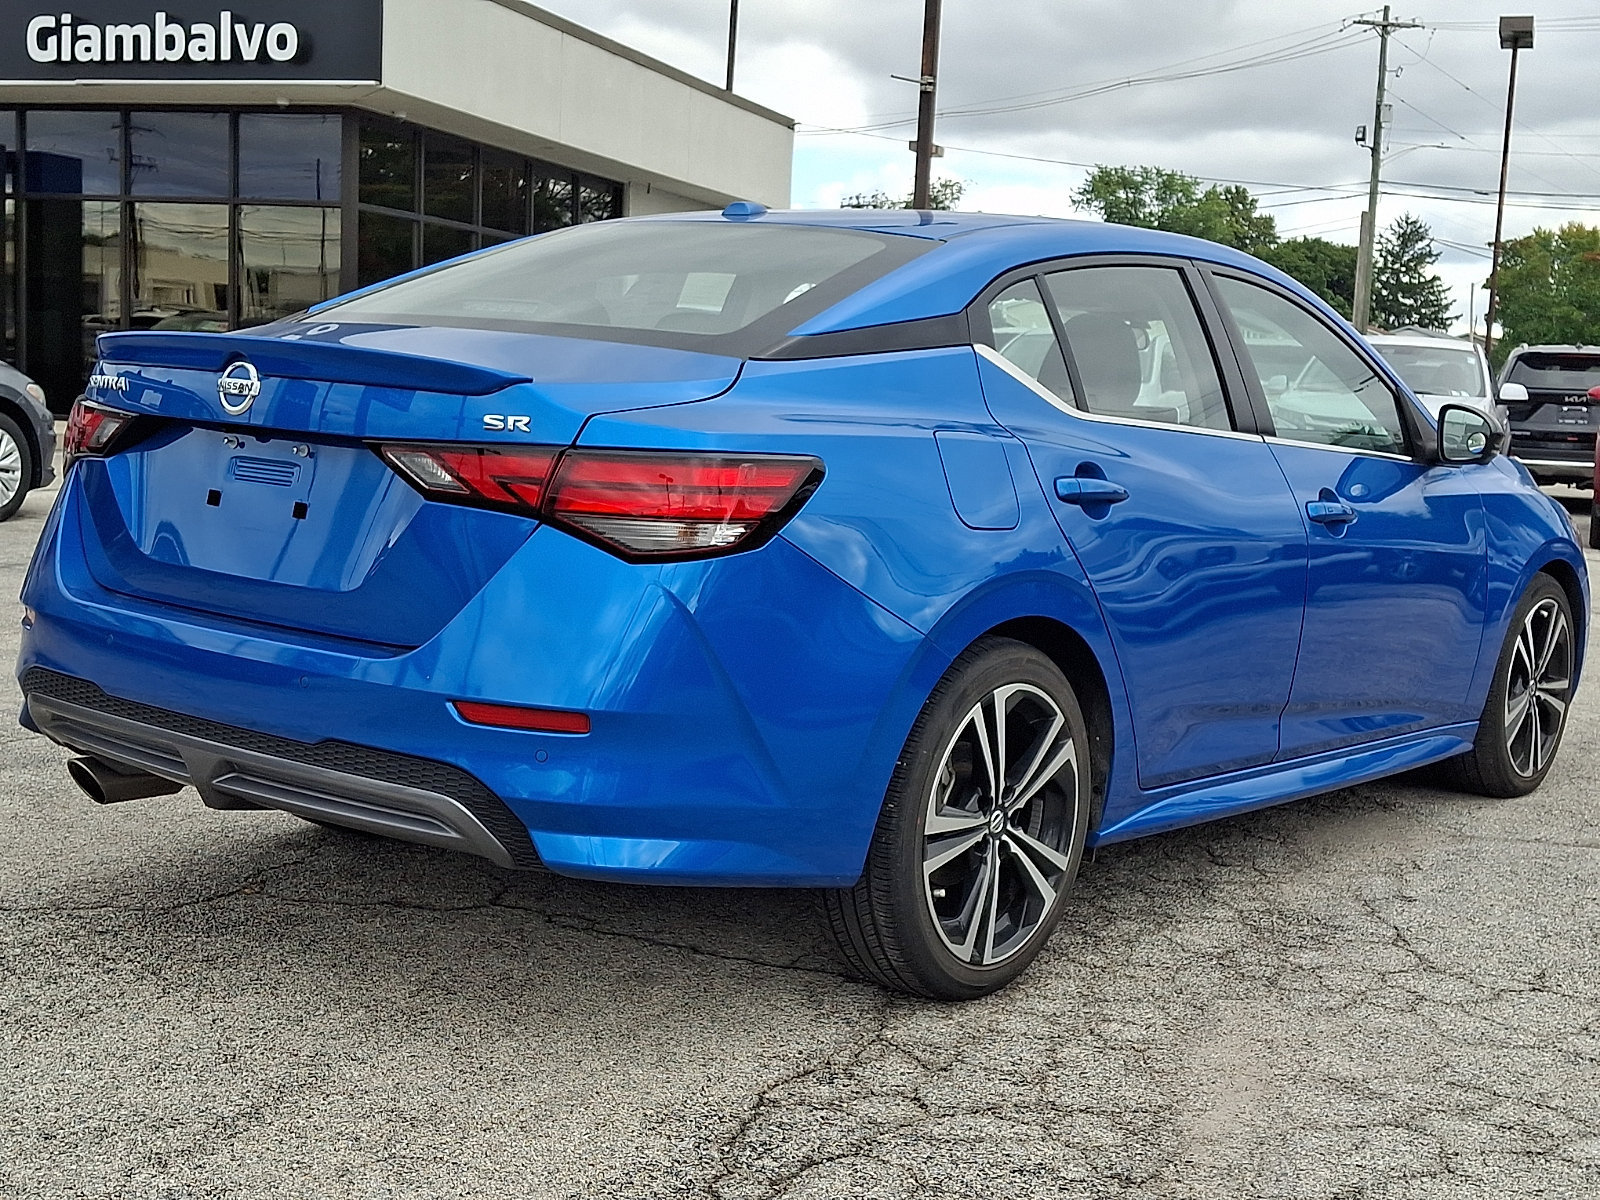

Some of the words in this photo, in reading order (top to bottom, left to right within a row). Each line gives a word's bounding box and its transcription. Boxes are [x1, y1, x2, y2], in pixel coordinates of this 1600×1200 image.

[26, 10, 299, 63] Giambalvo
[219, 380, 255, 394] NISSAN
[483, 414, 531, 432] SR
